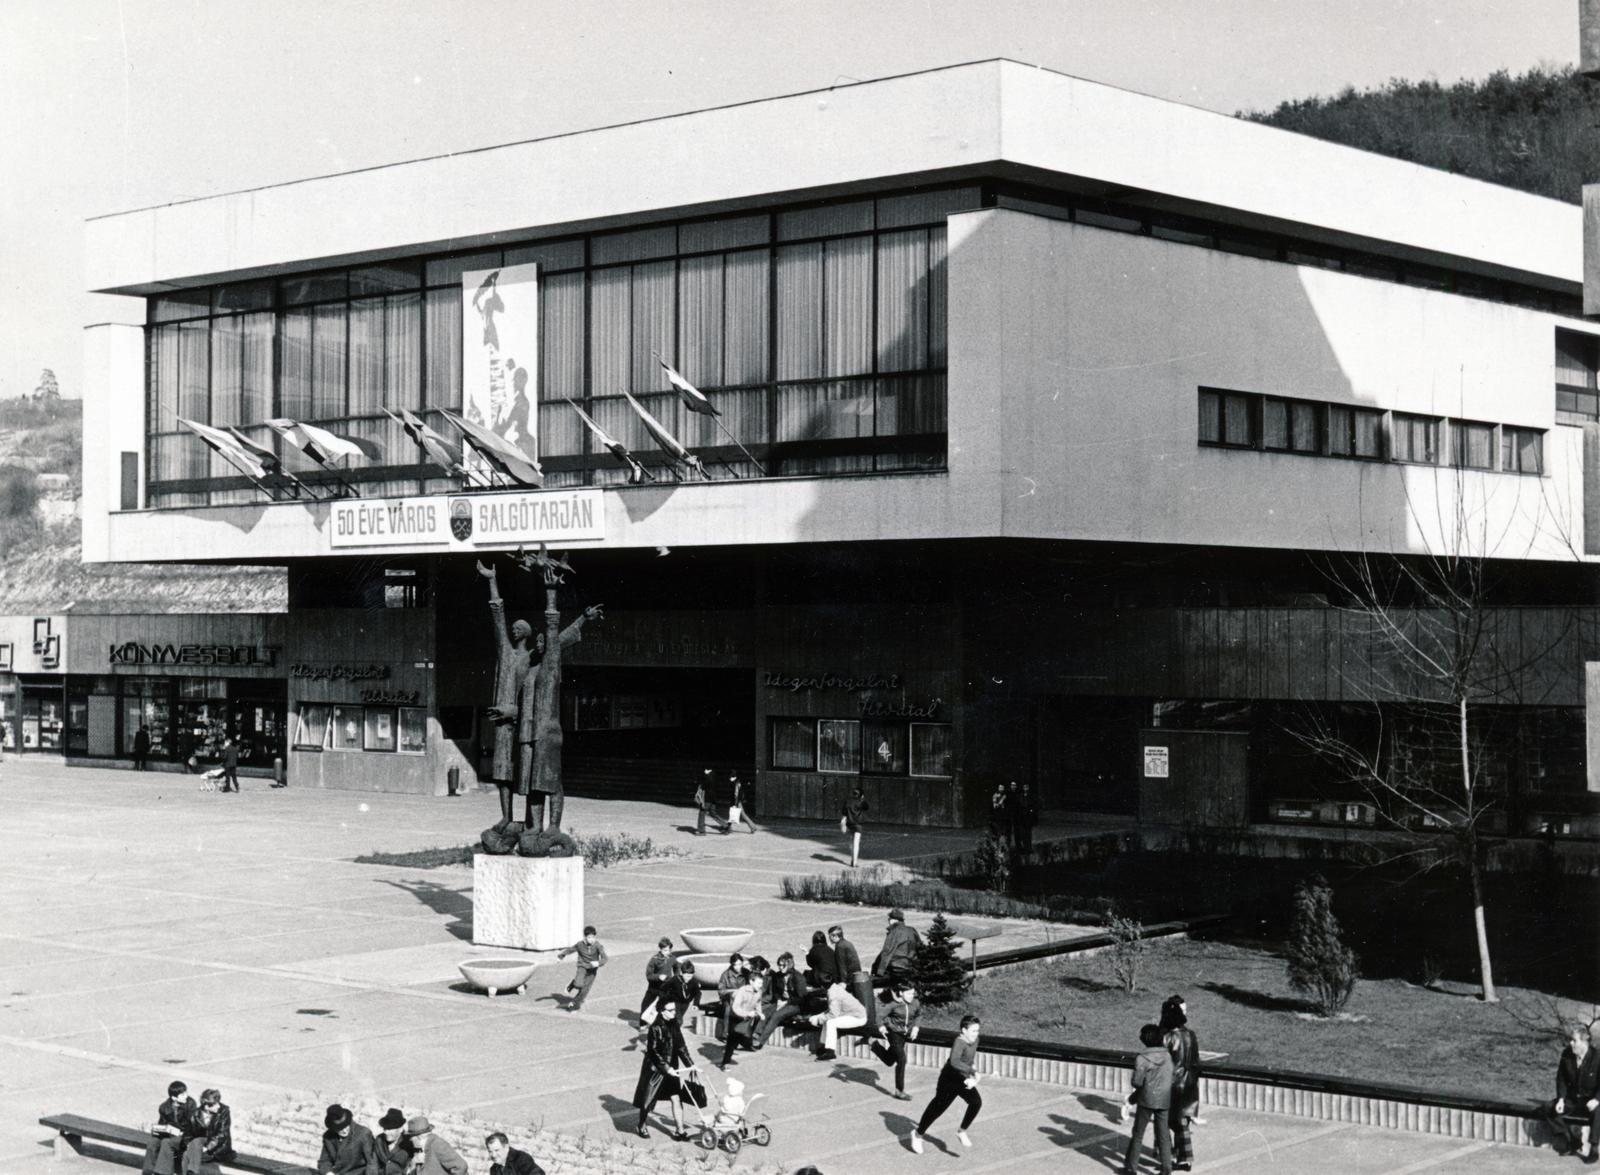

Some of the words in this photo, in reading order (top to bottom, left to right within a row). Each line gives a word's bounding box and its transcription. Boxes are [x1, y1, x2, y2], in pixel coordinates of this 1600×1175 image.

[338, 510, 354, 536] 50
[359, 504, 384, 536] ÉVE
[388, 501, 437, 535] VÁROS
[480, 496, 593, 533] SALGÓTARJÁN
[109, 642, 281, 666] KÖNYVESBOLT
